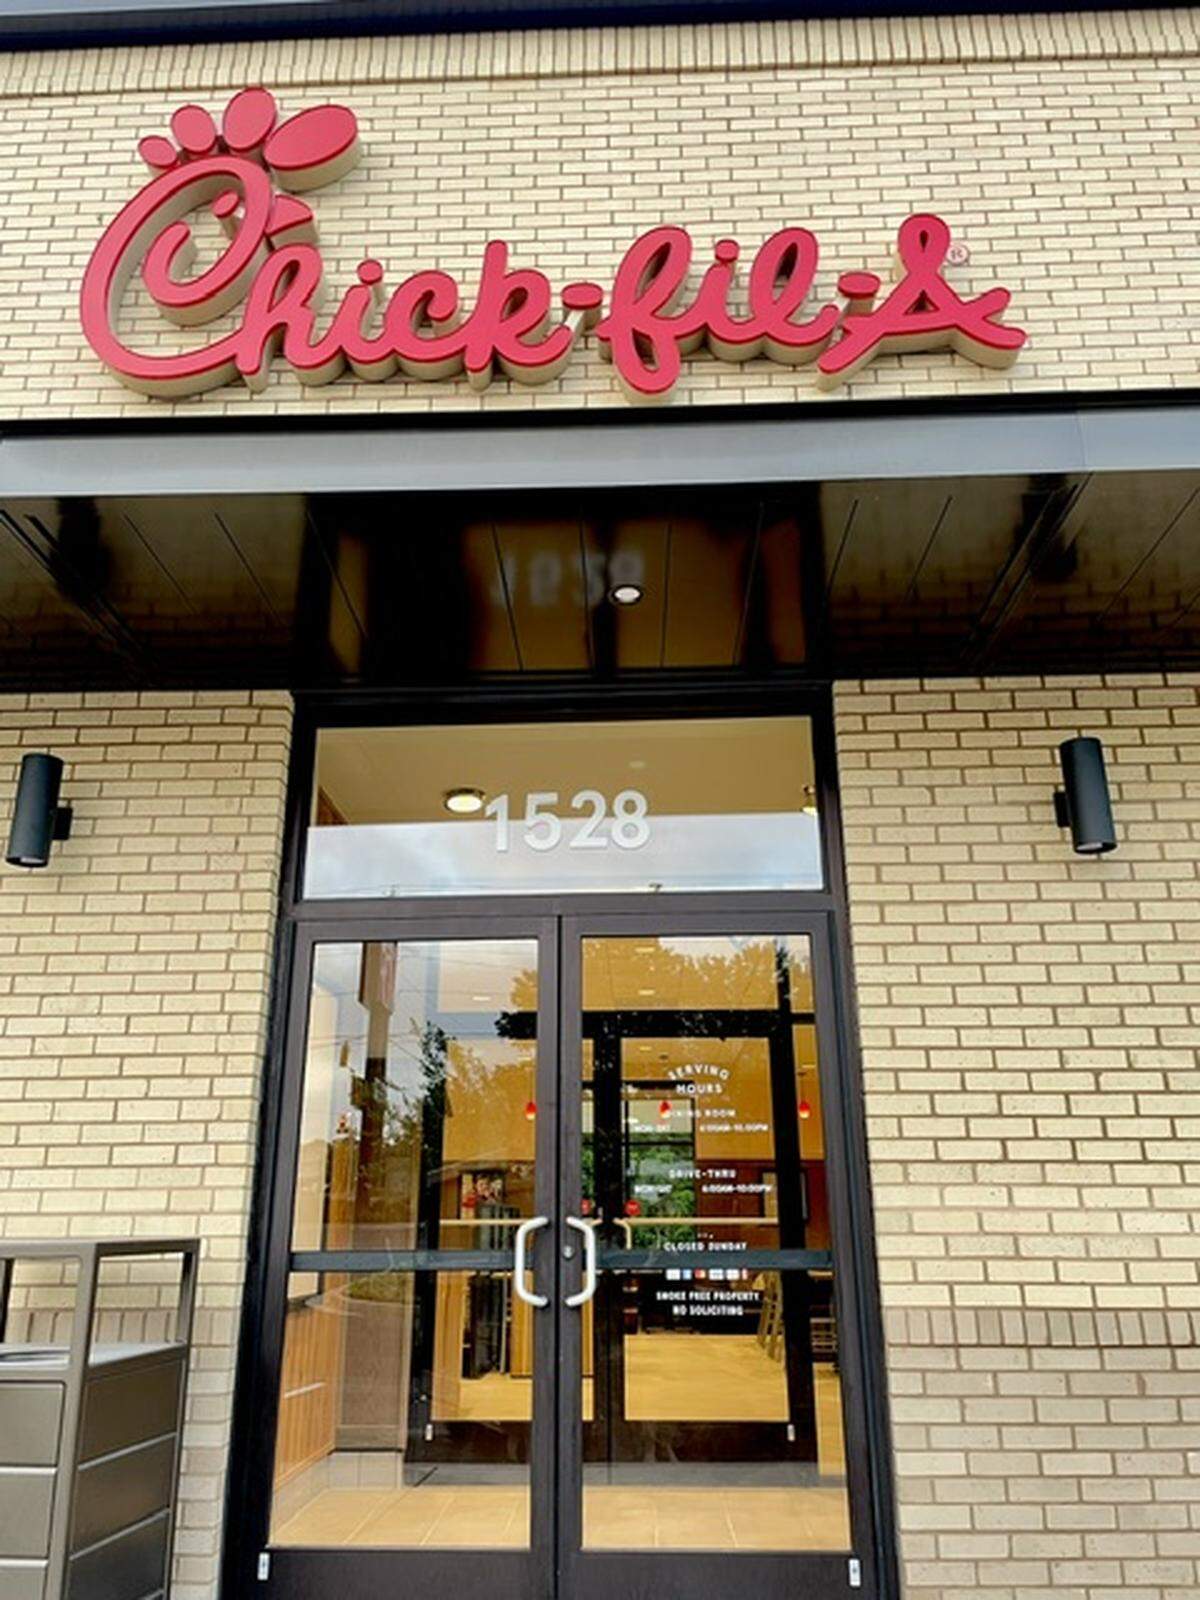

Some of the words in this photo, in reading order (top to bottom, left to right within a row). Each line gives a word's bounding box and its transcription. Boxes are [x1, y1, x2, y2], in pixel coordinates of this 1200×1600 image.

[80, 88, 1026, 402] Chick-fil-A
[484, 790, 650, 852] 1528
[667, 1064, 730, 1080] SERVING
[676, 1083, 723, 1095] HOURS
[704, 1109, 736, 1118] ROOM
[663, 1242, 705, 1252] CLOSED
[708, 1242, 748, 1251] SUNDAY
[656, 1291, 687, 1301] SMOKE
[689, 1291, 711, 1301] FREE
[713, 1291, 760, 1301] PROPERTY
[672, 1305, 687, 1316] NO
[689, 1305, 744, 1316] SOLICITING
